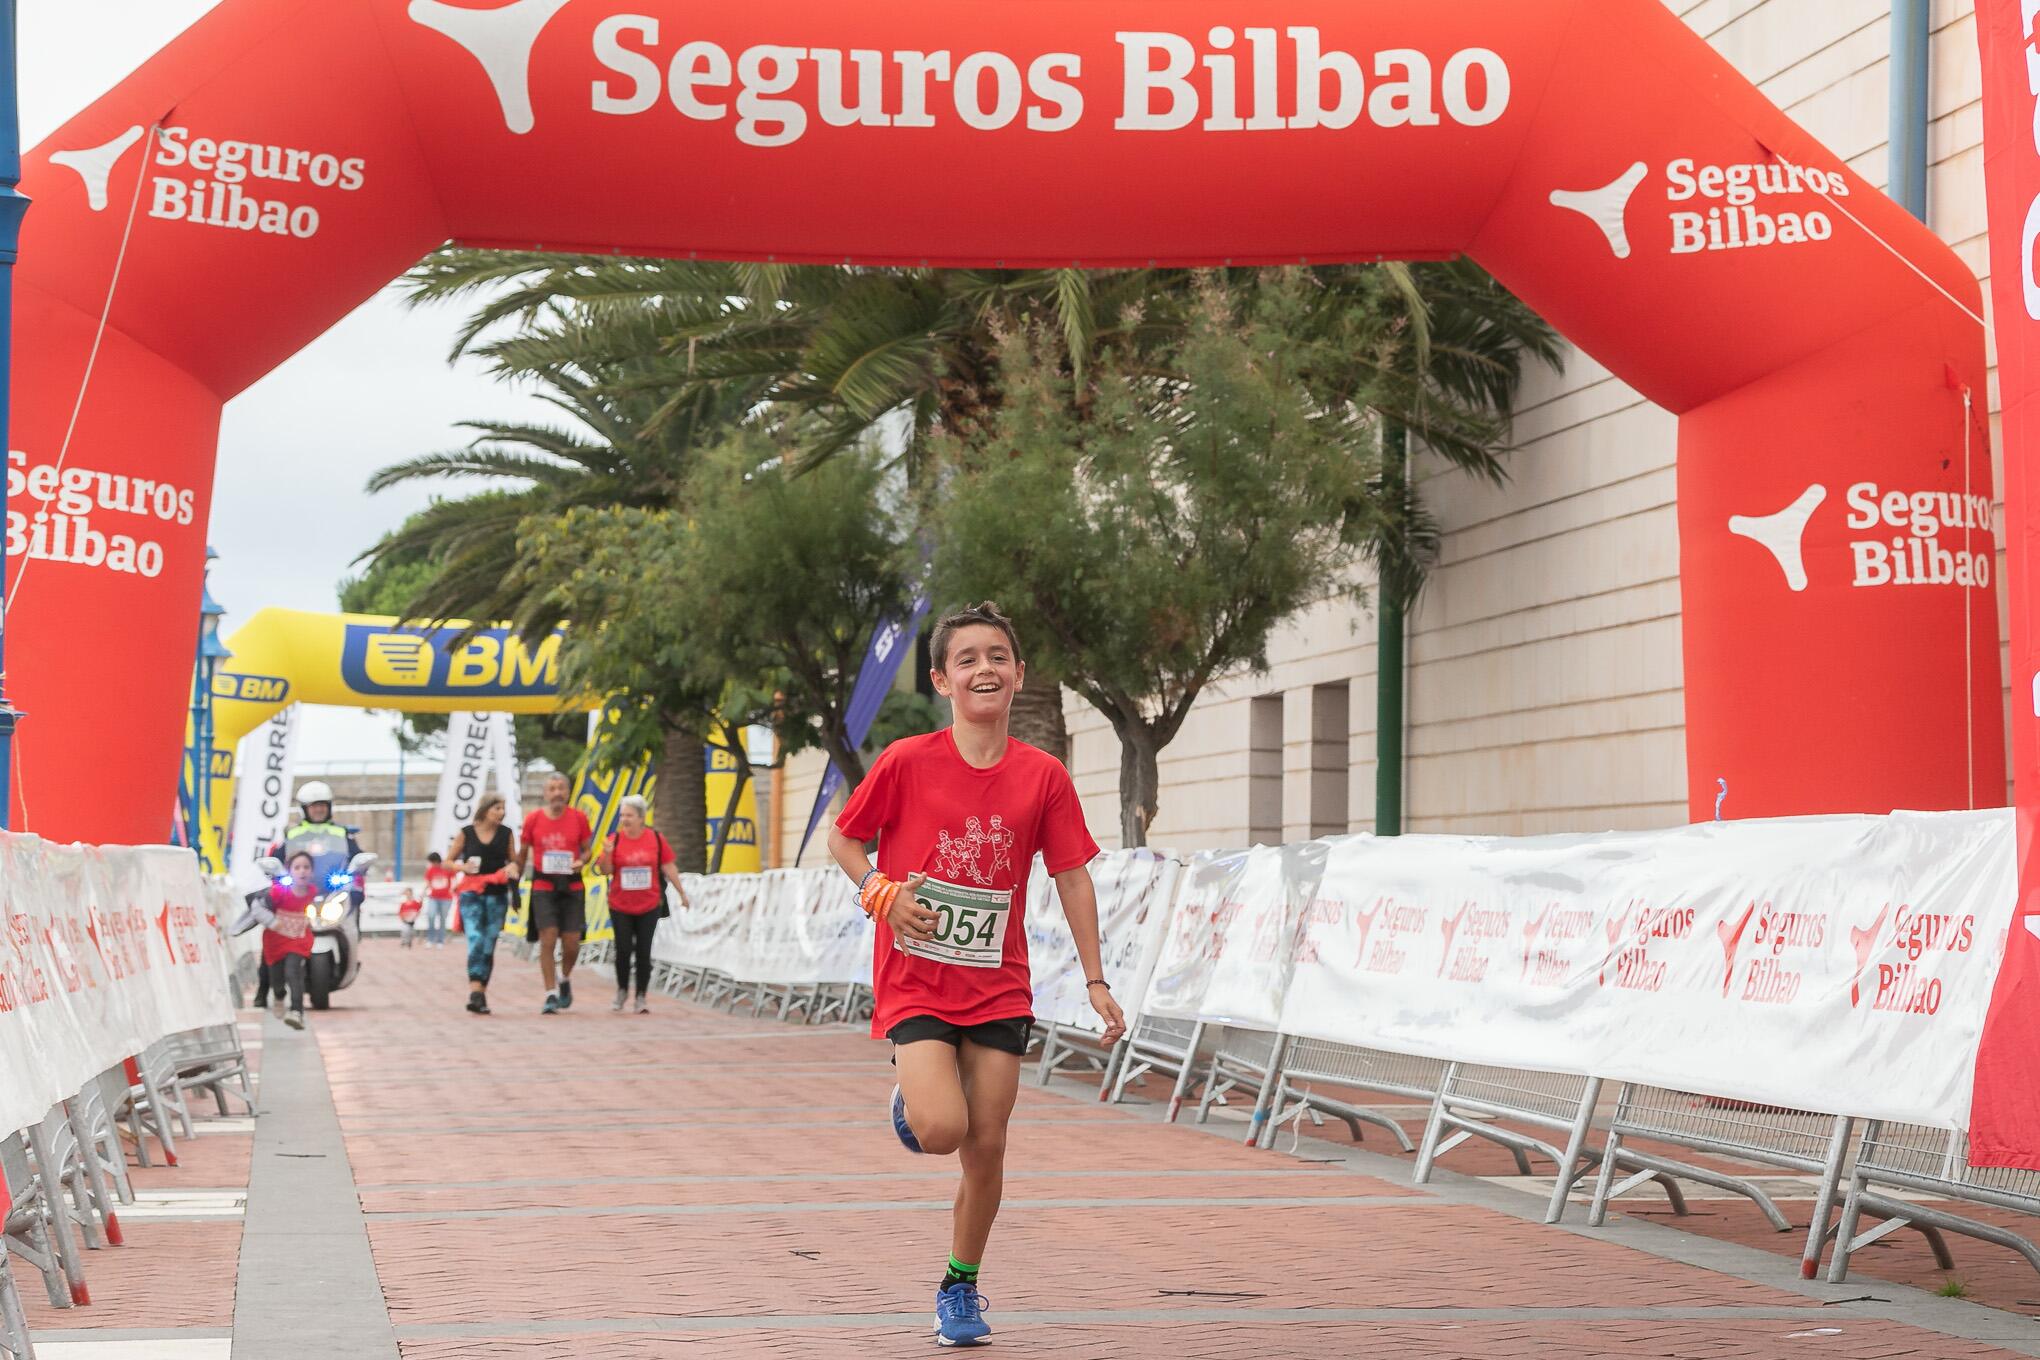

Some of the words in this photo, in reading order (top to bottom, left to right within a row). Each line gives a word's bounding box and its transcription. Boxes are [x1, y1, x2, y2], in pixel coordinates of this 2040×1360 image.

[591, 13, 1084, 148] Seguros
[1114, 25, 1511, 132] Bilbao
[155, 126, 366, 191] Seguros
[1665, 157, 1850, 206] Seguros
[148, 176, 320, 239] Bilbao
[1669, 204, 1833, 254] Bilbao
[7, 449, 195, 526] Seguros
[1849, 536, 1990, 589] Bilbao
[446, 634, 563, 688] BM
[239, 676, 285, 701] BM
[1462, 901, 1512, 944] Seguros
[1754, 901, 1828, 956] Seguros
[1741, 957, 1801, 1005] Bilbao
[1872, 962, 1942, 1016] Bilbao
